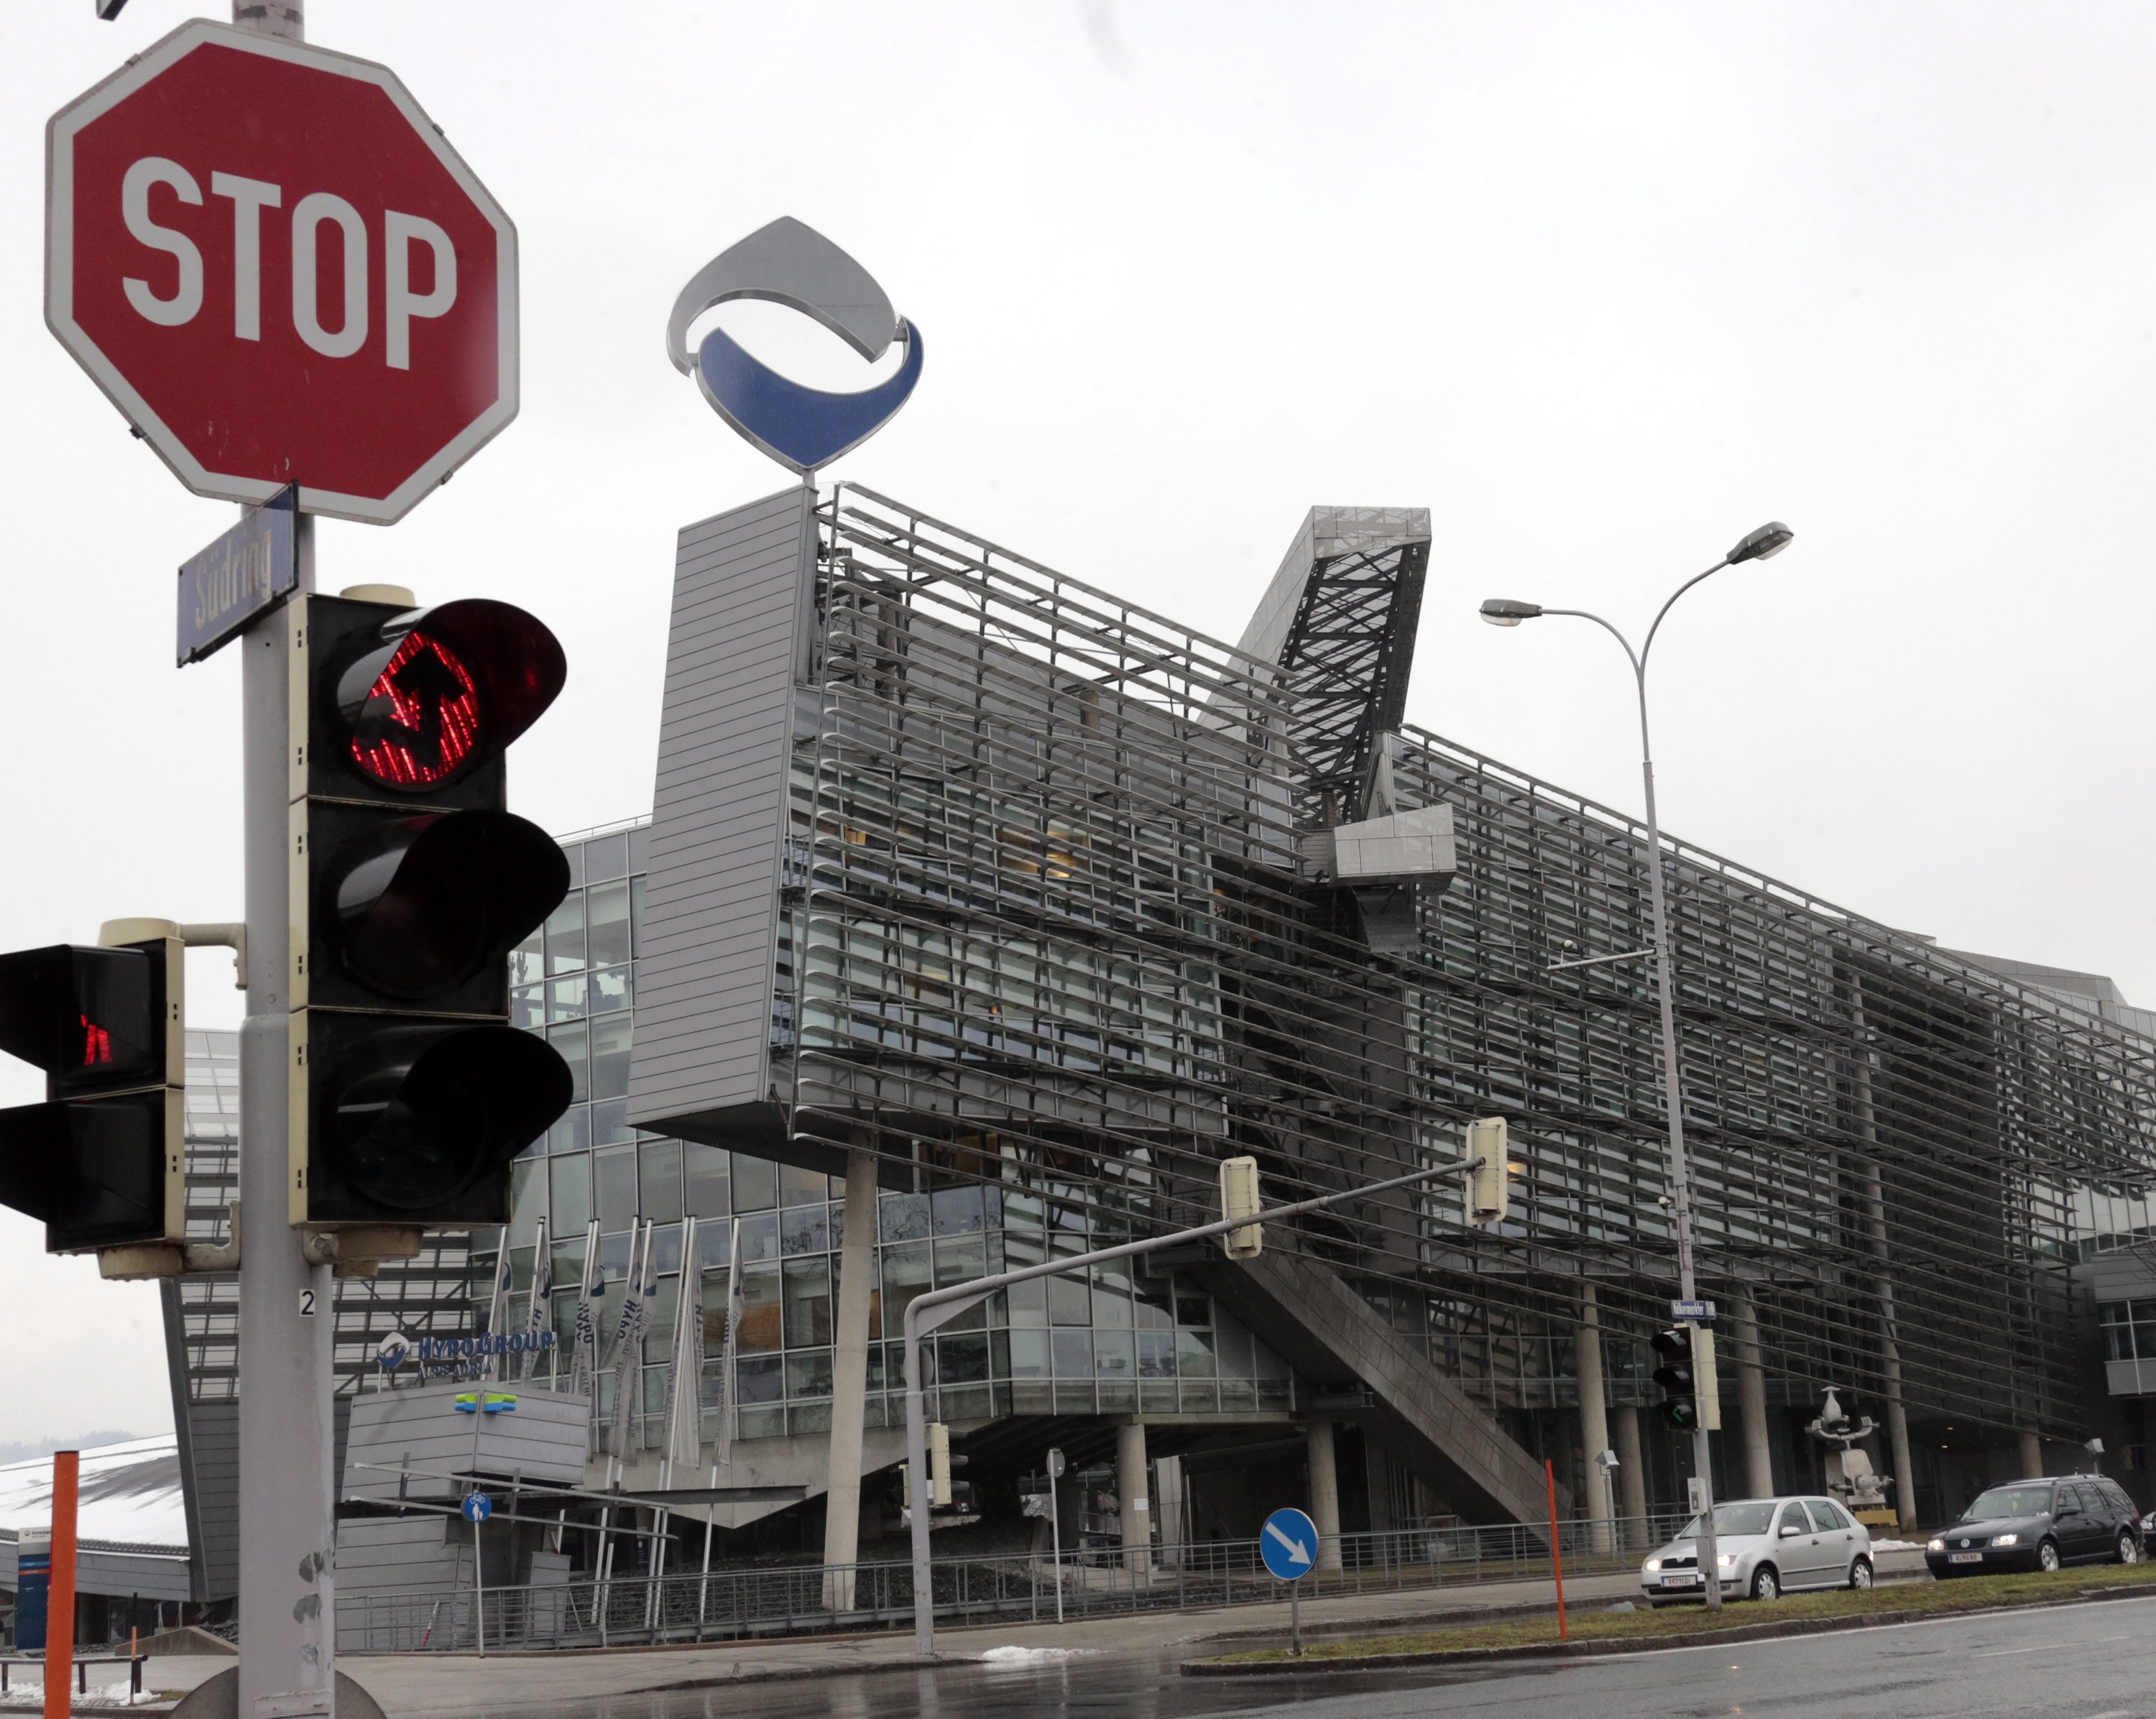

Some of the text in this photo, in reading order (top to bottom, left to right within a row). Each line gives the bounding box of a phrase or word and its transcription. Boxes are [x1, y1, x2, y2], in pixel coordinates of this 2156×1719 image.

[122, 156, 457, 371] STOP
[195, 527, 272, 630] Südring
[301, 1290, 315, 1316] 2
